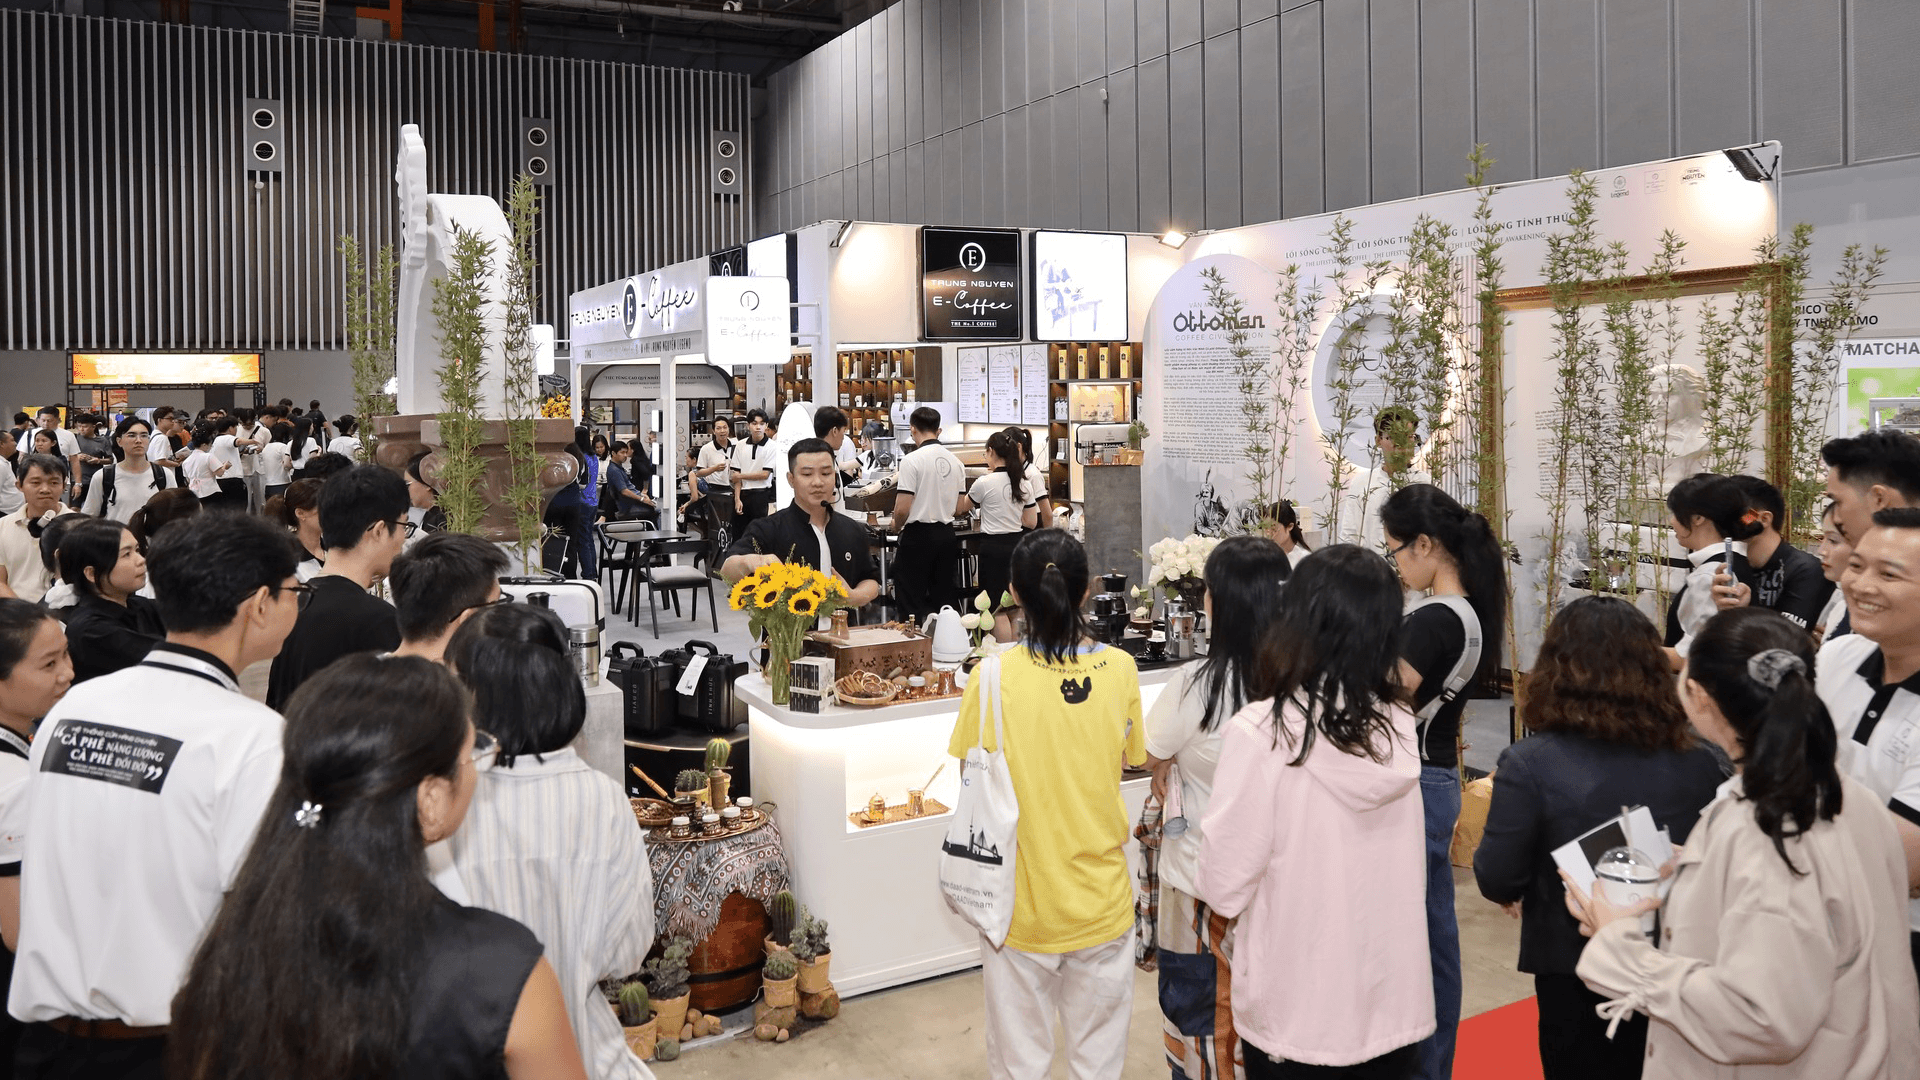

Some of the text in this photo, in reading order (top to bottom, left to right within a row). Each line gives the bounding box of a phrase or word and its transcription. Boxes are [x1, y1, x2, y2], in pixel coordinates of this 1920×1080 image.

[970, 280, 1013, 289] NGUYEN
[1175, 333, 1205, 342] COFFEE
[1847, 341, 1920, 356] MATCHA
[79, 735, 105, 751] PHÊ
[88, 750, 114, 766] PHÊ
